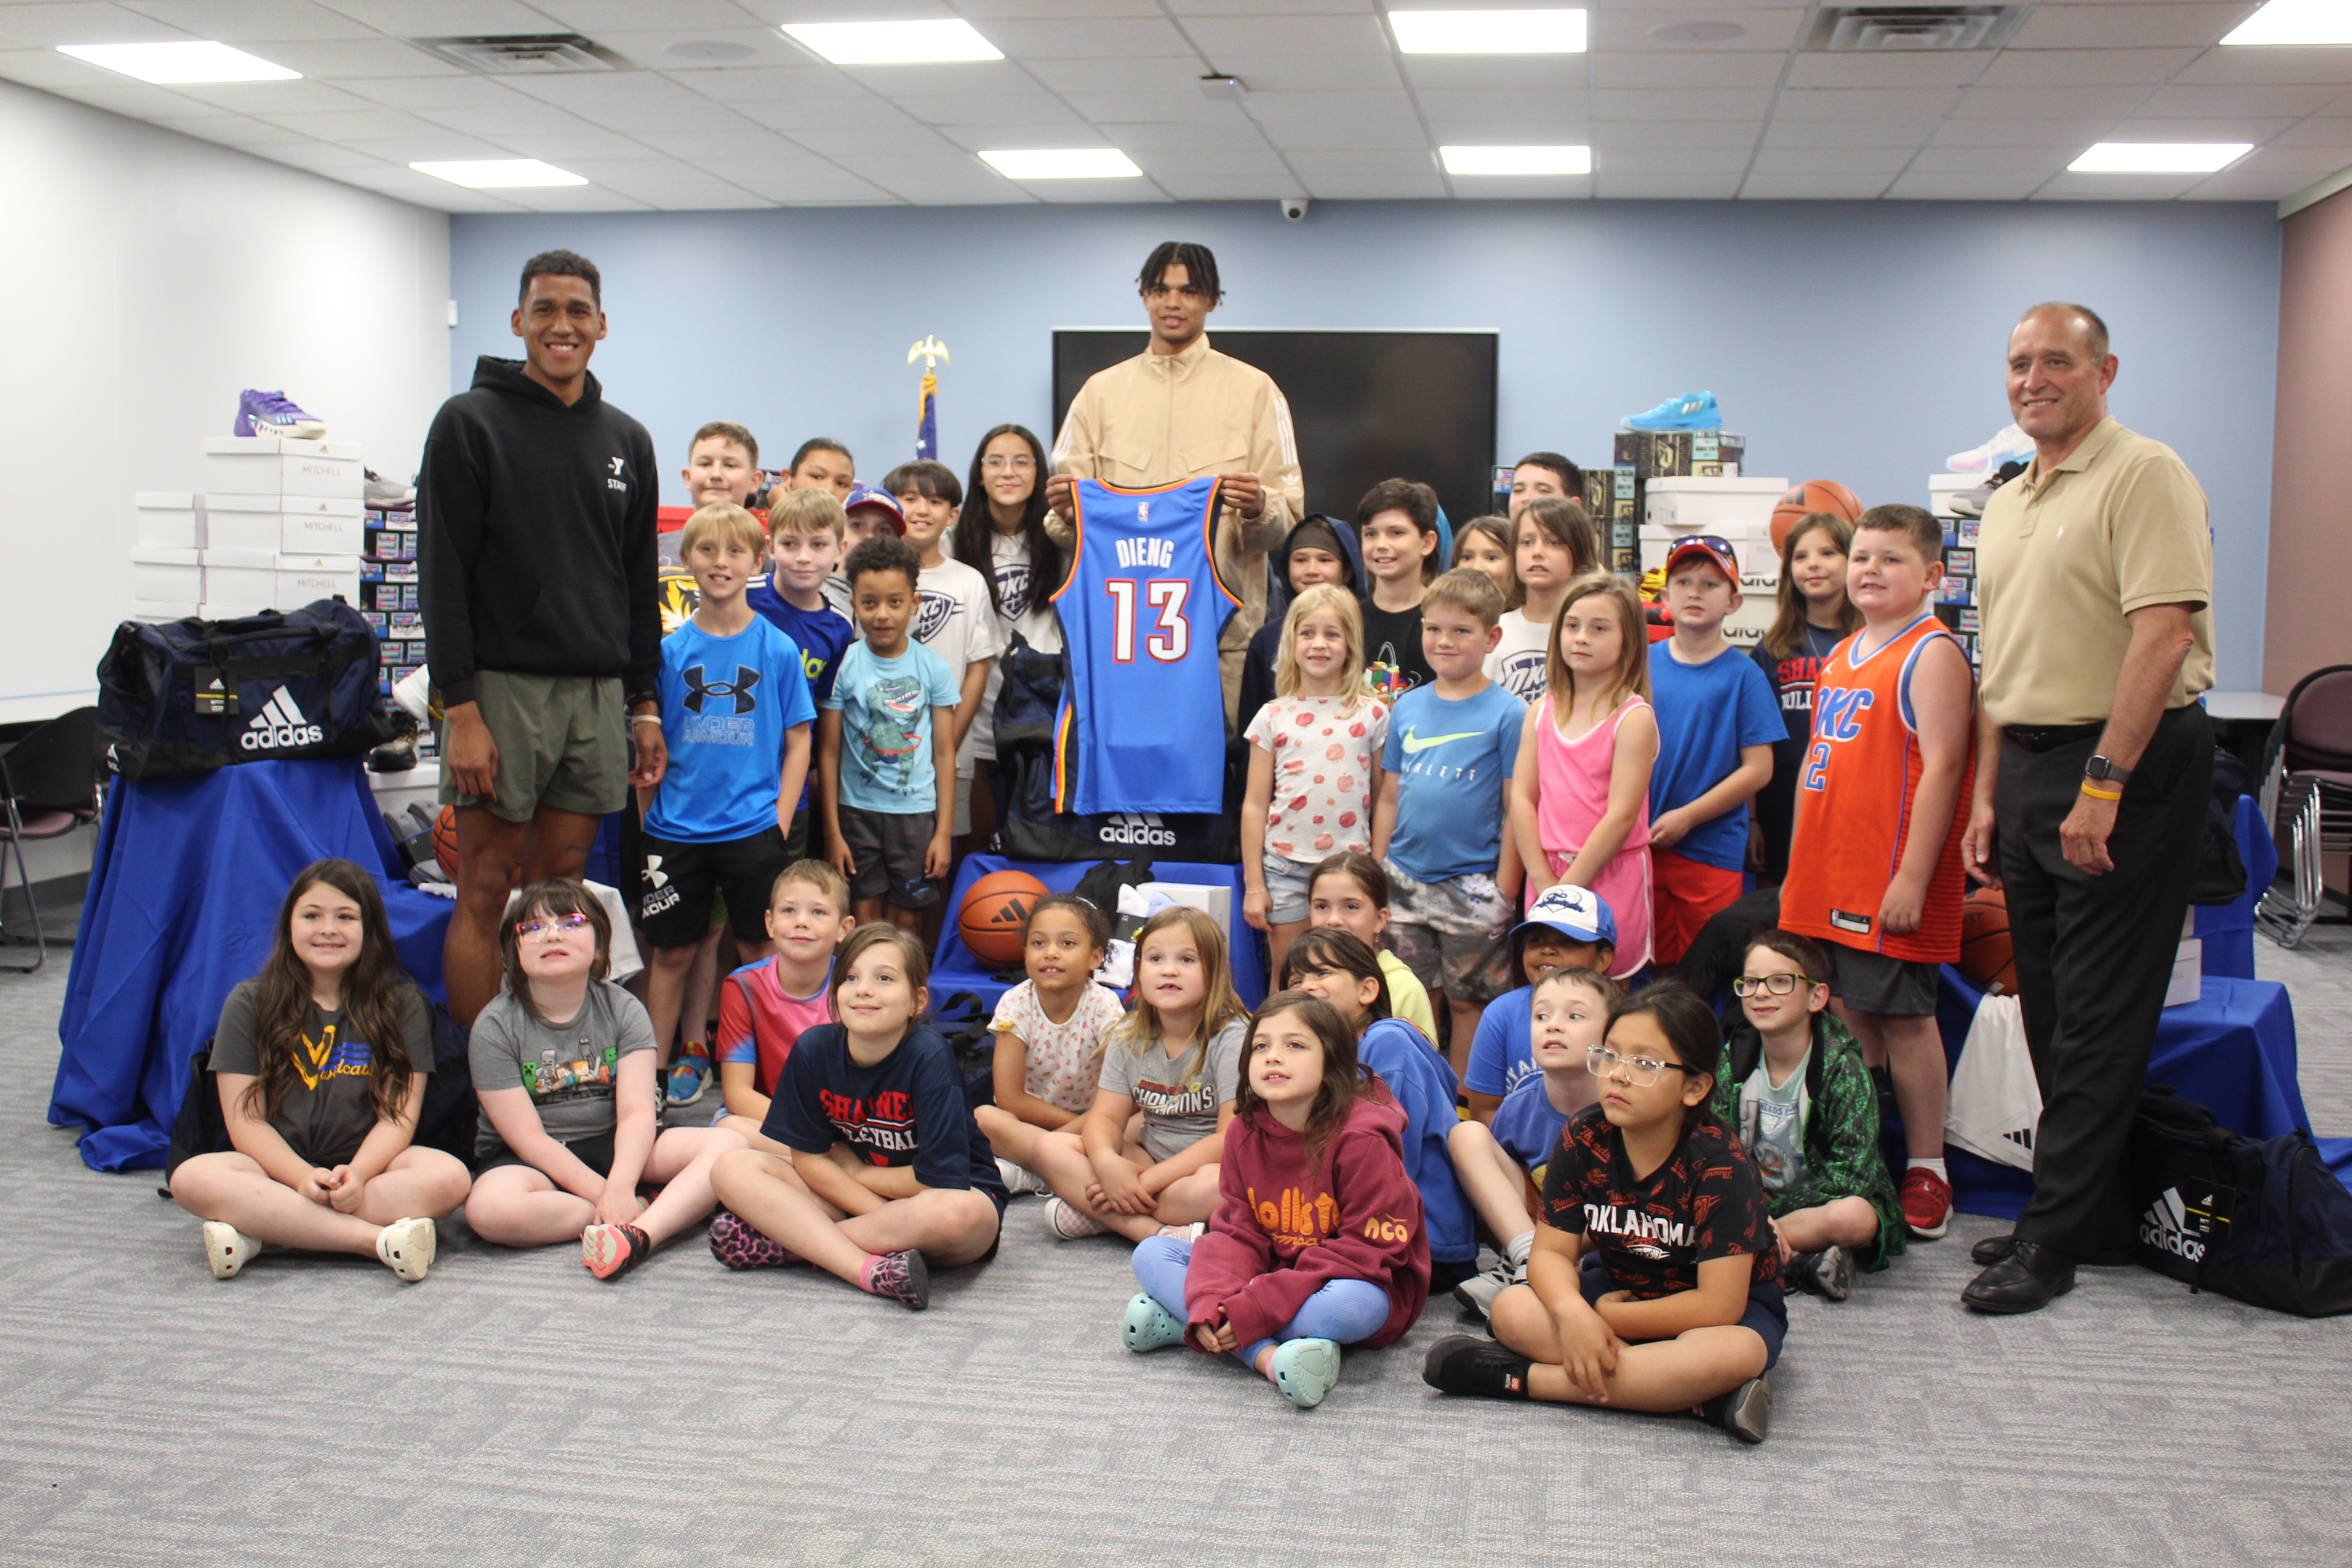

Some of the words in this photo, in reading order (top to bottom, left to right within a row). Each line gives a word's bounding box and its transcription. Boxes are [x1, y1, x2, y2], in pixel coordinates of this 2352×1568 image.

[303, 466, 342, 476] MITCHELL
[607, 478, 627, 493] STAFF
[305, 522, 344, 532] MITCHELL
[1115, 537, 1175, 569] DIENG
[297, 578, 337, 588] MITCHELL
[1105, 578, 1191, 664] 13
[683, 715, 755, 732] UNDER
[240, 723, 324, 751] adidas
[681, 730, 754, 746] ARMOUR
[1804, 741, 1832, 792] 2
[1099, 823, 1177, 847] adidas
[2139, 1223, 2206, 1263] adidas
